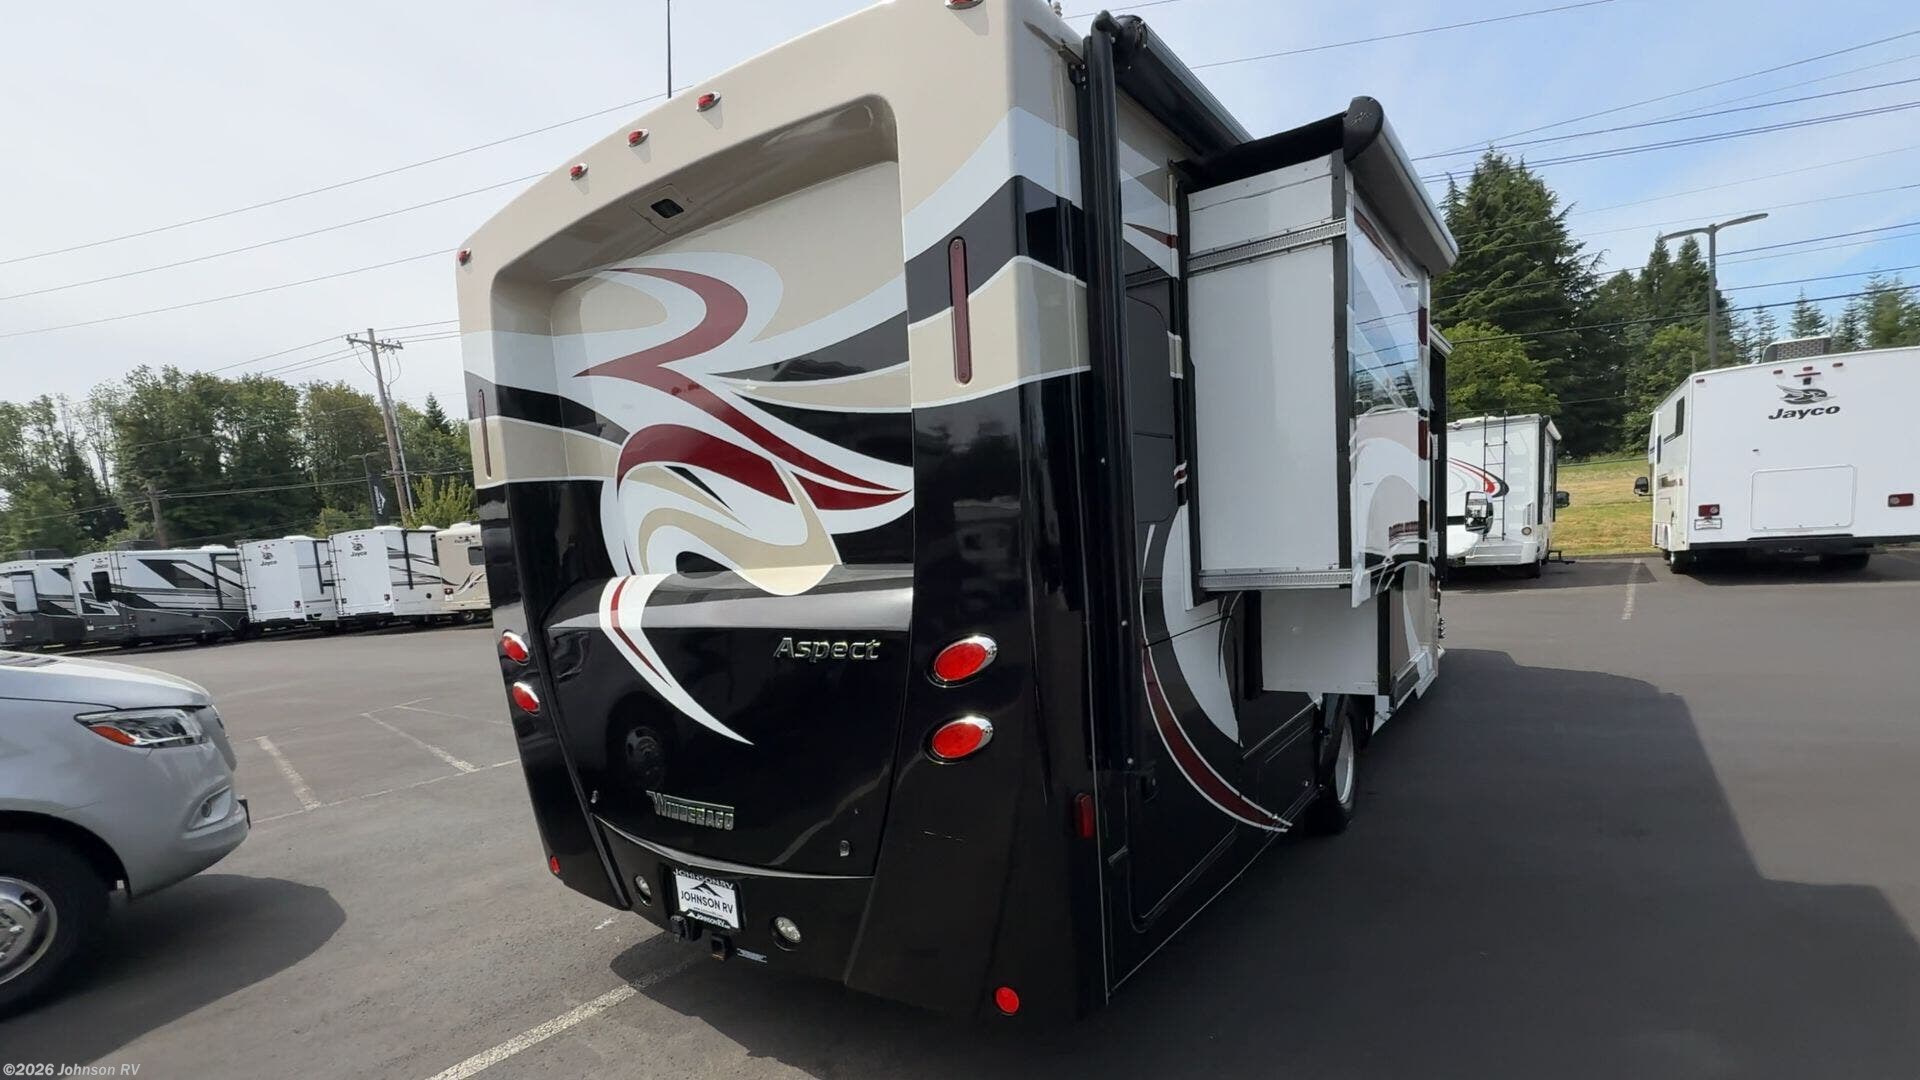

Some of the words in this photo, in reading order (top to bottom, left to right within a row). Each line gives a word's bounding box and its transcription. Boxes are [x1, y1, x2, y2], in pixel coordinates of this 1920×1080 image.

[1768, 406, 1841, 420] Jayco
[773, 637, 881, 663] Aspect
[681, 890, 721, 910] JOHNSON
[722, 902, 734, 914] RV
